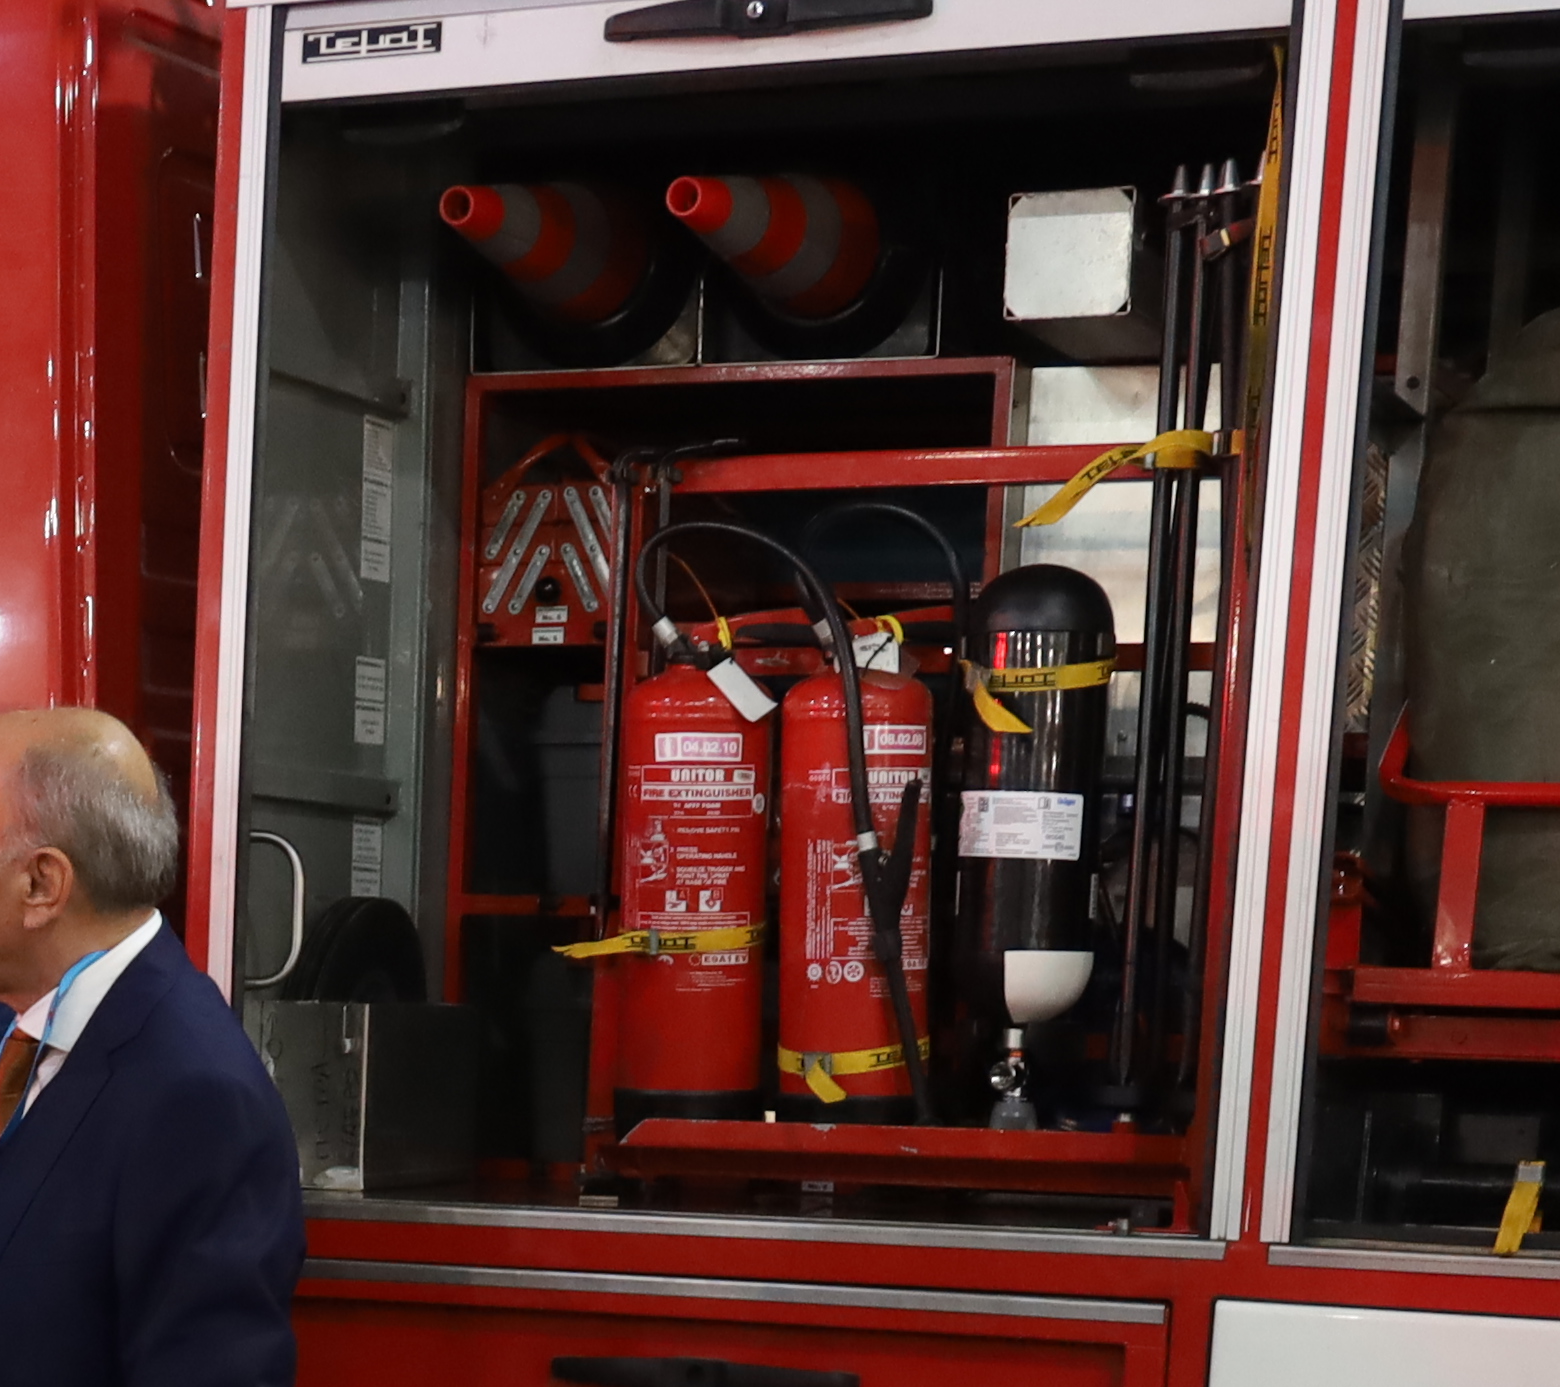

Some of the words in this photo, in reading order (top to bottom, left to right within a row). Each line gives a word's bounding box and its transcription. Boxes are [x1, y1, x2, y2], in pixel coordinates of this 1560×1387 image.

[670, 768, 725, 782] UNITOR
[643, 788, 665, 797] FIRE
[668, 787, 751, 798] EXTINGUISHER
